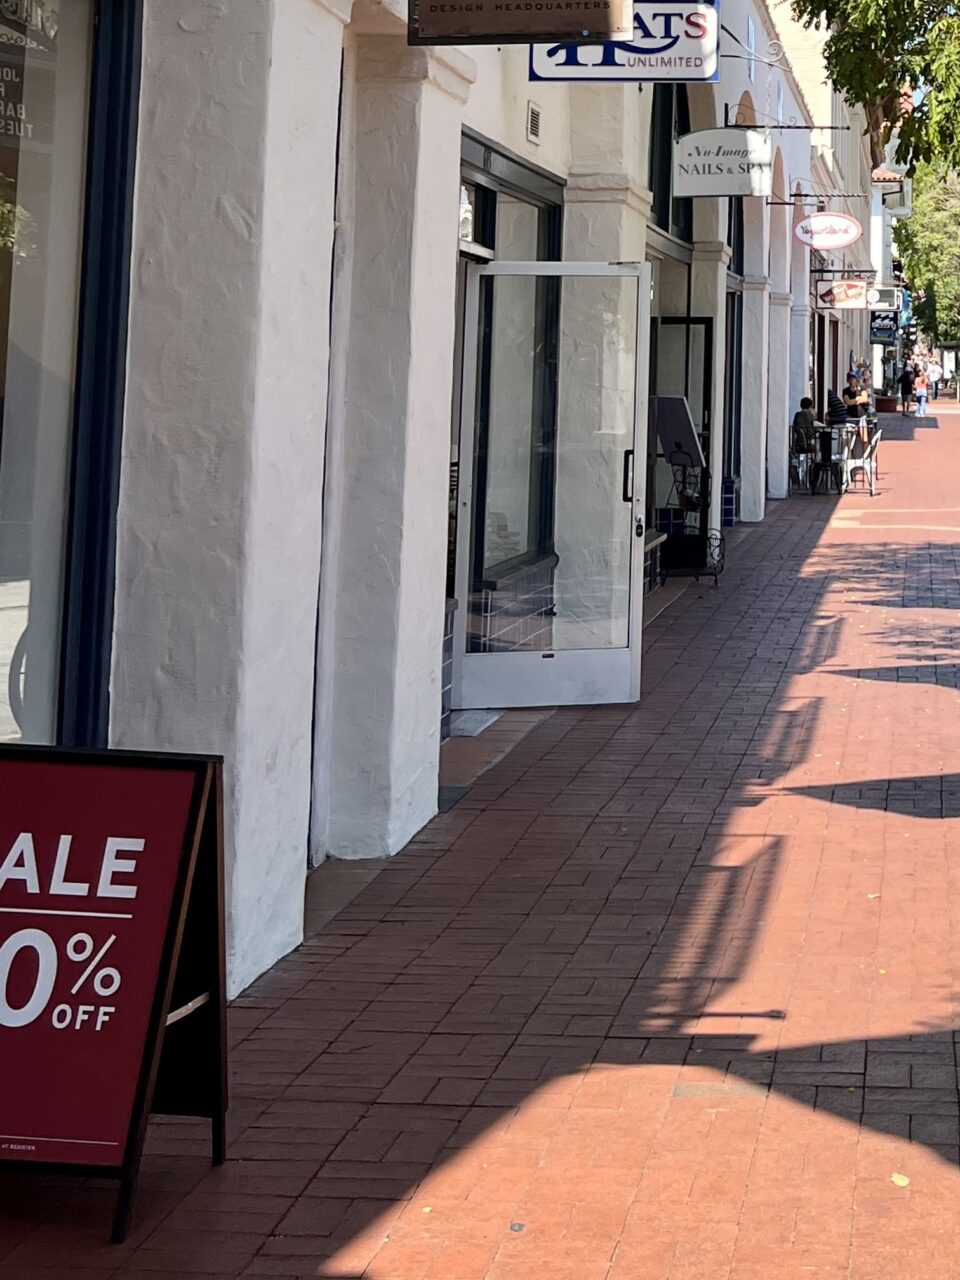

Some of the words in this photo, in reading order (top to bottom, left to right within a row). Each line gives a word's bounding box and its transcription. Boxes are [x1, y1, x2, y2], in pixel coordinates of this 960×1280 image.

[430, 3, 484, 13] DESIGN
[496, 1, 611, 12] HEADQUARTERS
[627, 57, 704, 68] UNLIMITED
[688, 145, 756, 159] Nu-Imag
[678, 163, 723, 175] NAILS
[0, 832, 145, 899] ALE
[51, 1003, 116, 1032] OFF
